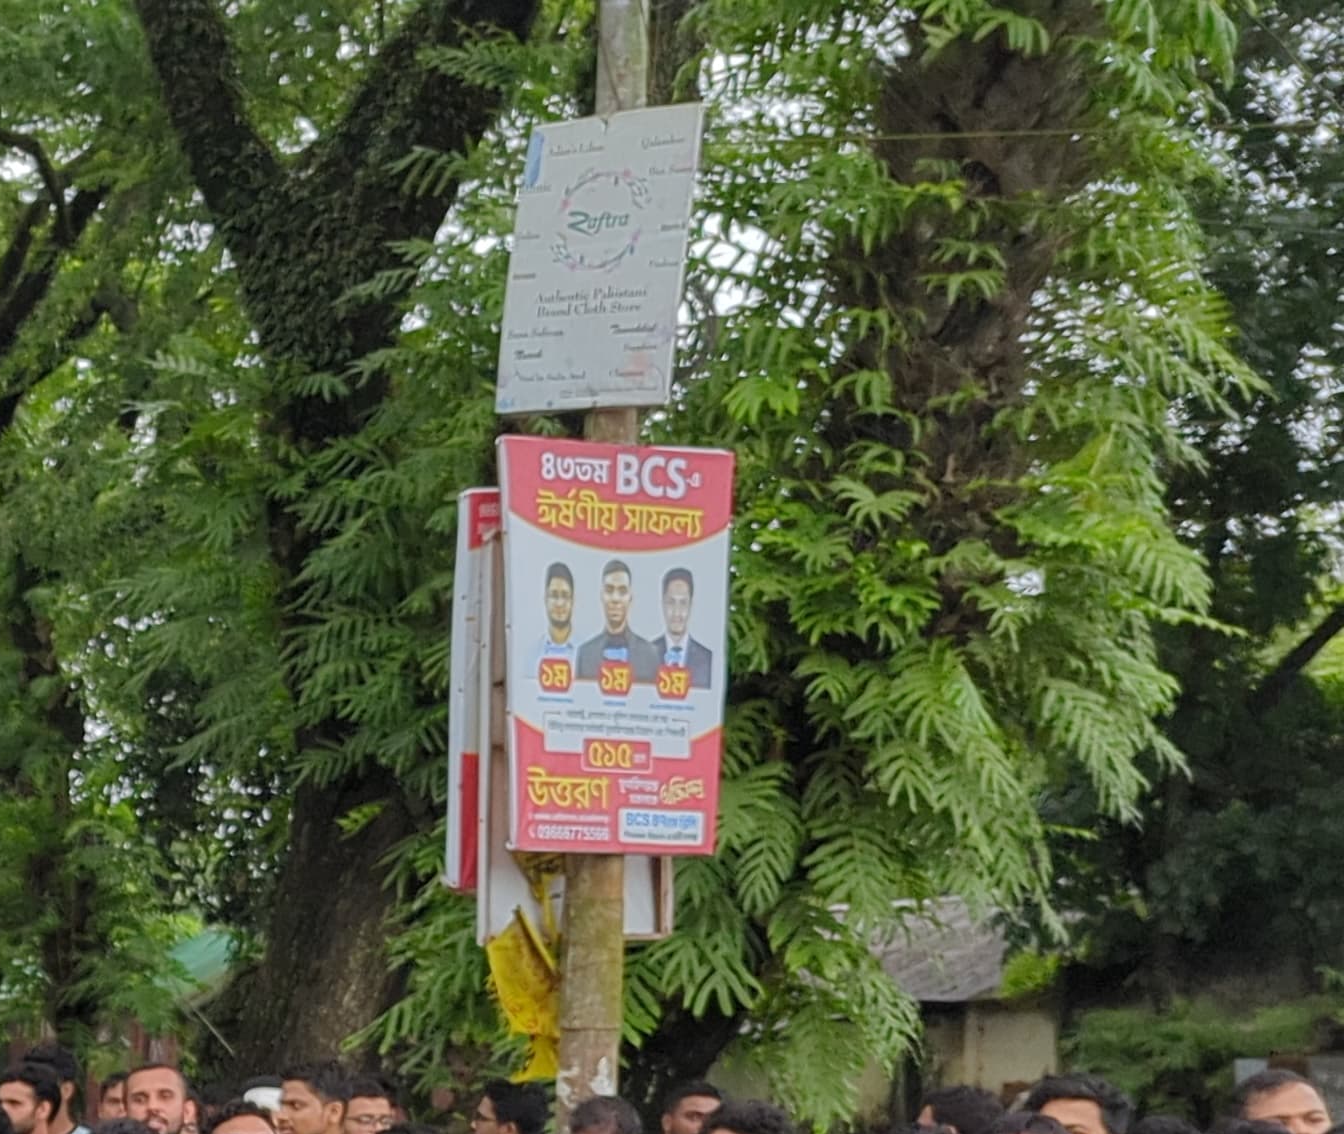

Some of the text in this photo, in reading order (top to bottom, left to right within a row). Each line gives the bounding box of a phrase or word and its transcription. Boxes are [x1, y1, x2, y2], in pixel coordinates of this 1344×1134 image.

[567, 210, 630, 237] Raftra
[541, 452, 611, 484] ৪৩তম
[536, 488, 704, 538] ঈর্ষণীয় সাফল্য
[541, 663, 569, 688] ১ম
[600, 666, 629, 691] ১ম
[659, 670, 686, 695] ১ম
[588, 741, 633, 768] ৫১৫
[527, 766, 609, 809] উত্তরণ
